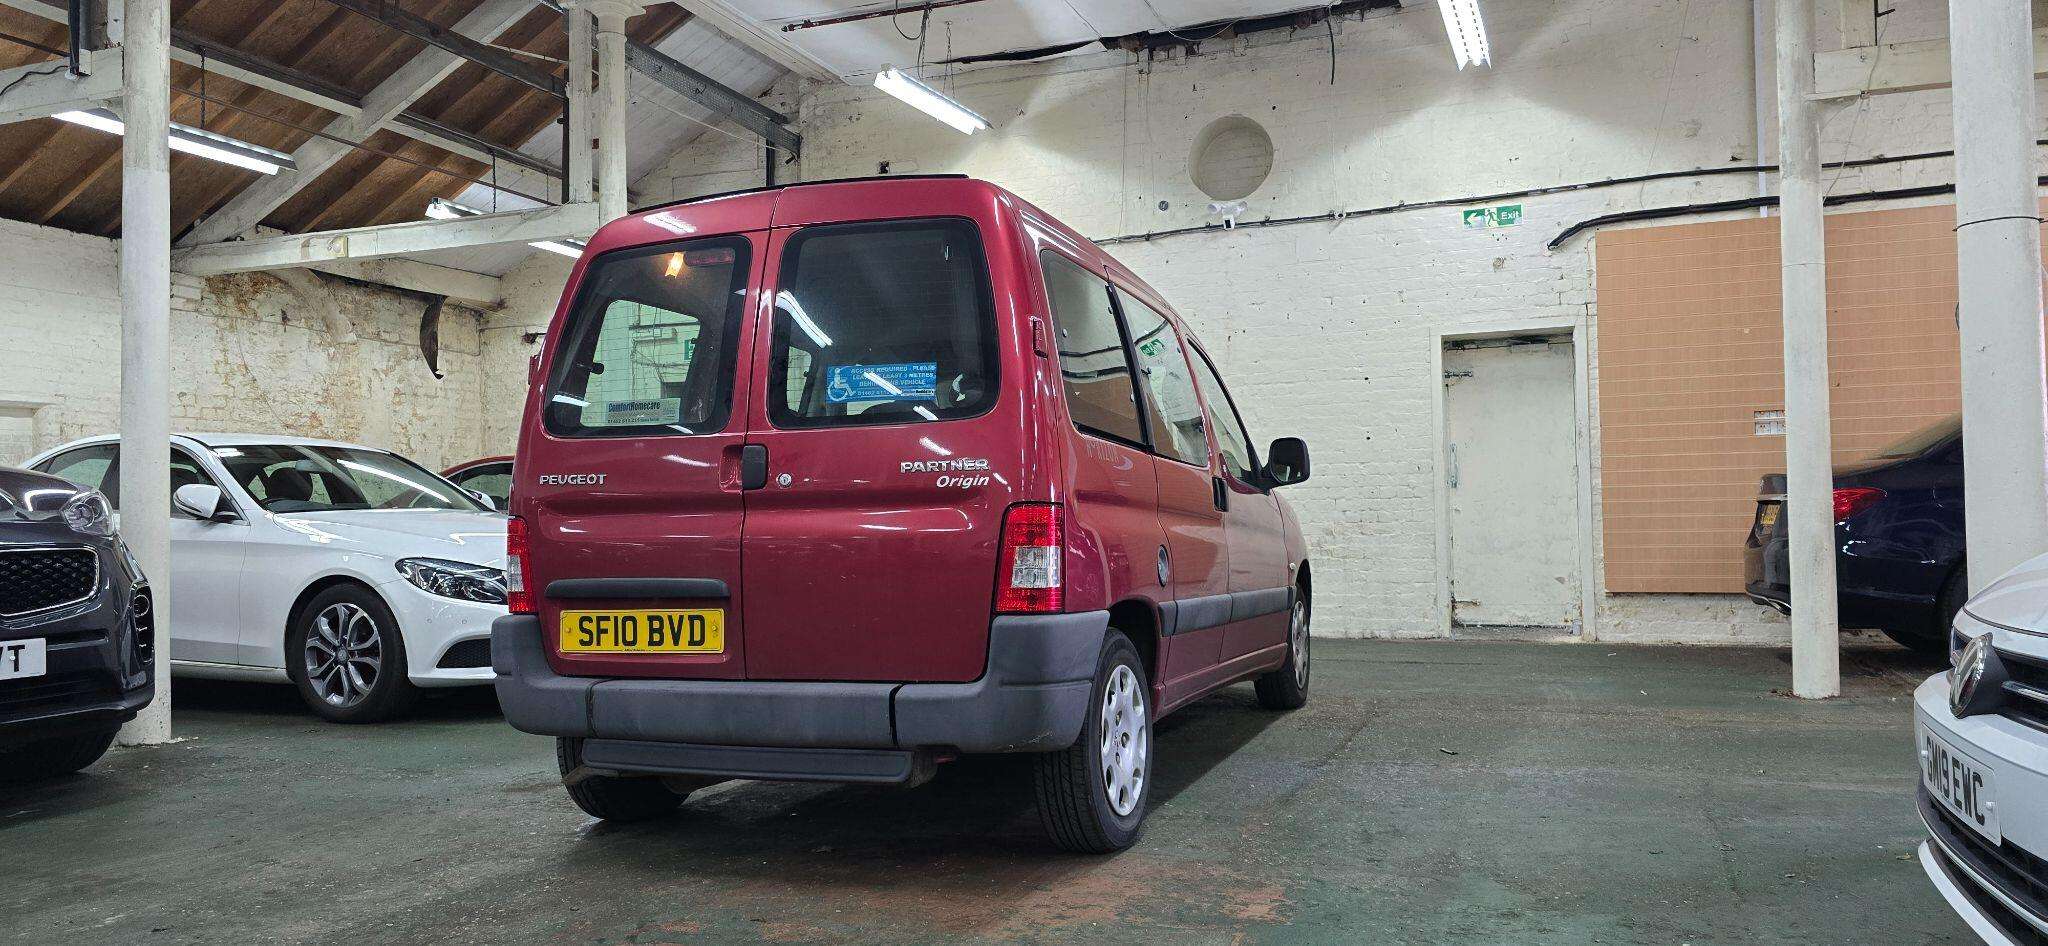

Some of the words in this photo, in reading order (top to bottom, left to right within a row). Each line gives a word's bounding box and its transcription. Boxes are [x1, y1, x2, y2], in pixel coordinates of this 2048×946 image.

[1501, 211, 1520, 219] Exit
[876, 365, 908, 373] REQUIRED
[900, 458, 991, 474] PARTNER
[539, 473, 607, 486] PEUGEOT
[936, 474, 990, 489] Origin
[578, 615, 638, 647] SF10
[647, 614, 706, 647] BVD
[1926, 735, 1950, 800] GM19
[1951, 755, 1985, 827] EWC
